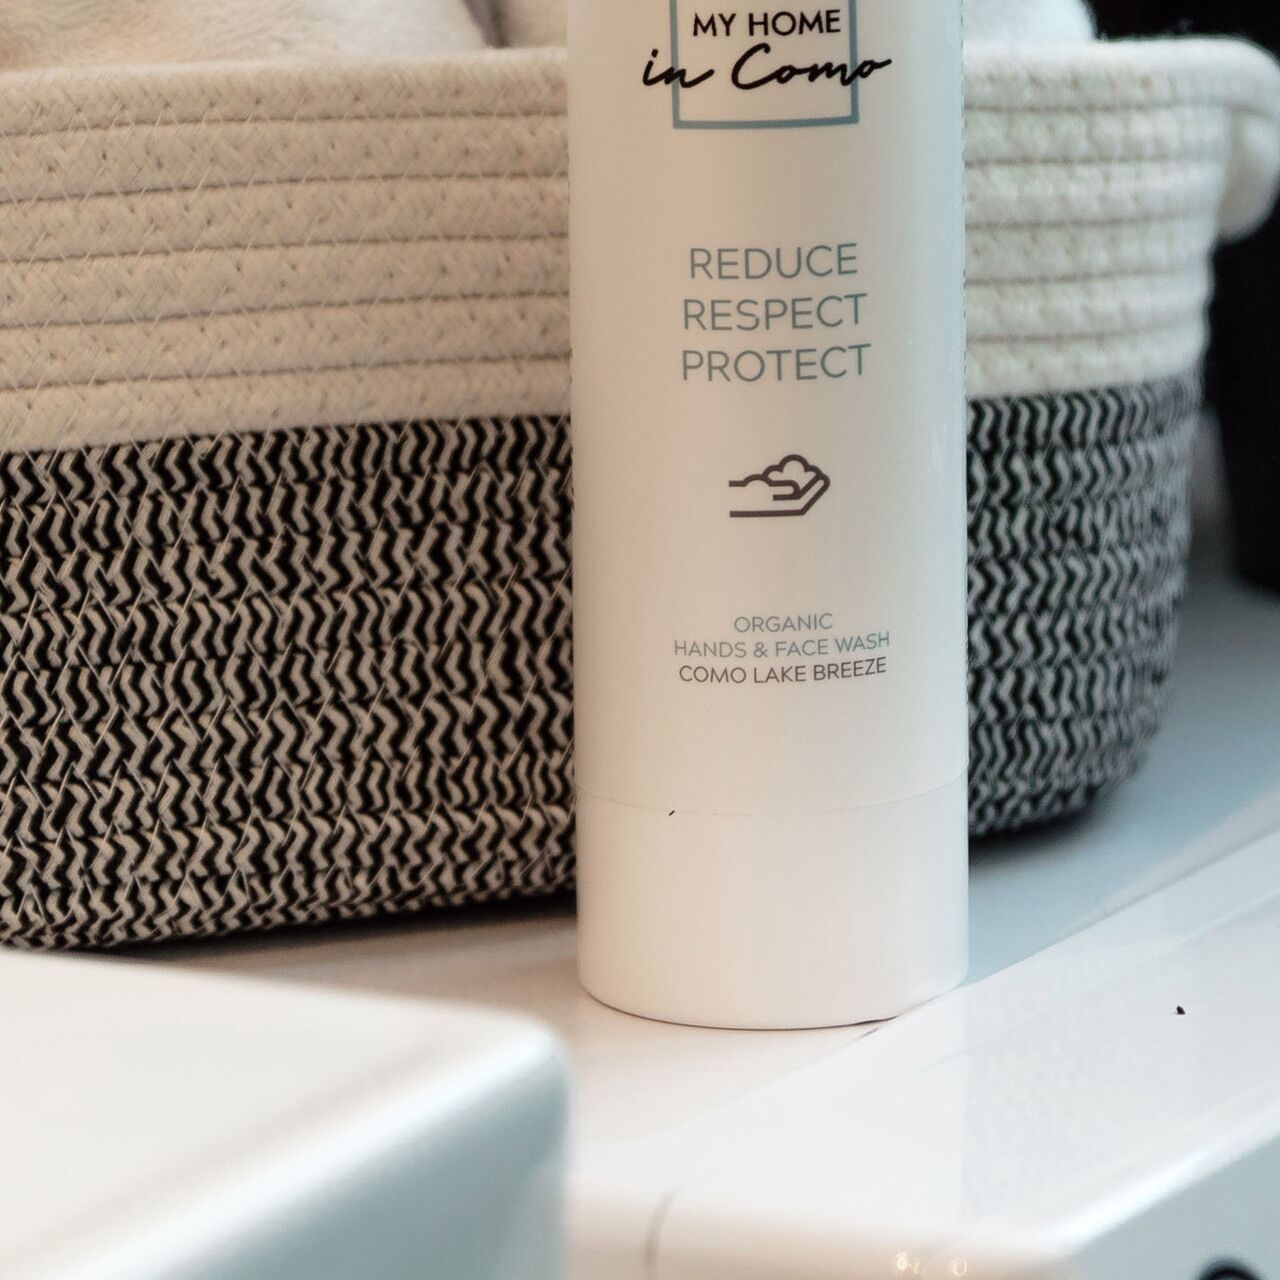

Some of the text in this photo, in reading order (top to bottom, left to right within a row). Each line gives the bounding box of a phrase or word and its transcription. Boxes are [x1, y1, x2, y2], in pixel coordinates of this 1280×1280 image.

[692, 8, 842, 38] MY HOME
[642, 42, 893, 90] in Como
[689, 242, 859, 280] REDUCE
[683, 292, 869, 331] RESPECT
[682, 342, 872, 383] PROTECT
[733, 612, 833, 633] ORGANIC
[673, 630, 891, 659] HANDS & FACE WASH
[678, 656, 887, 685] COMO LAKE BREEZE
